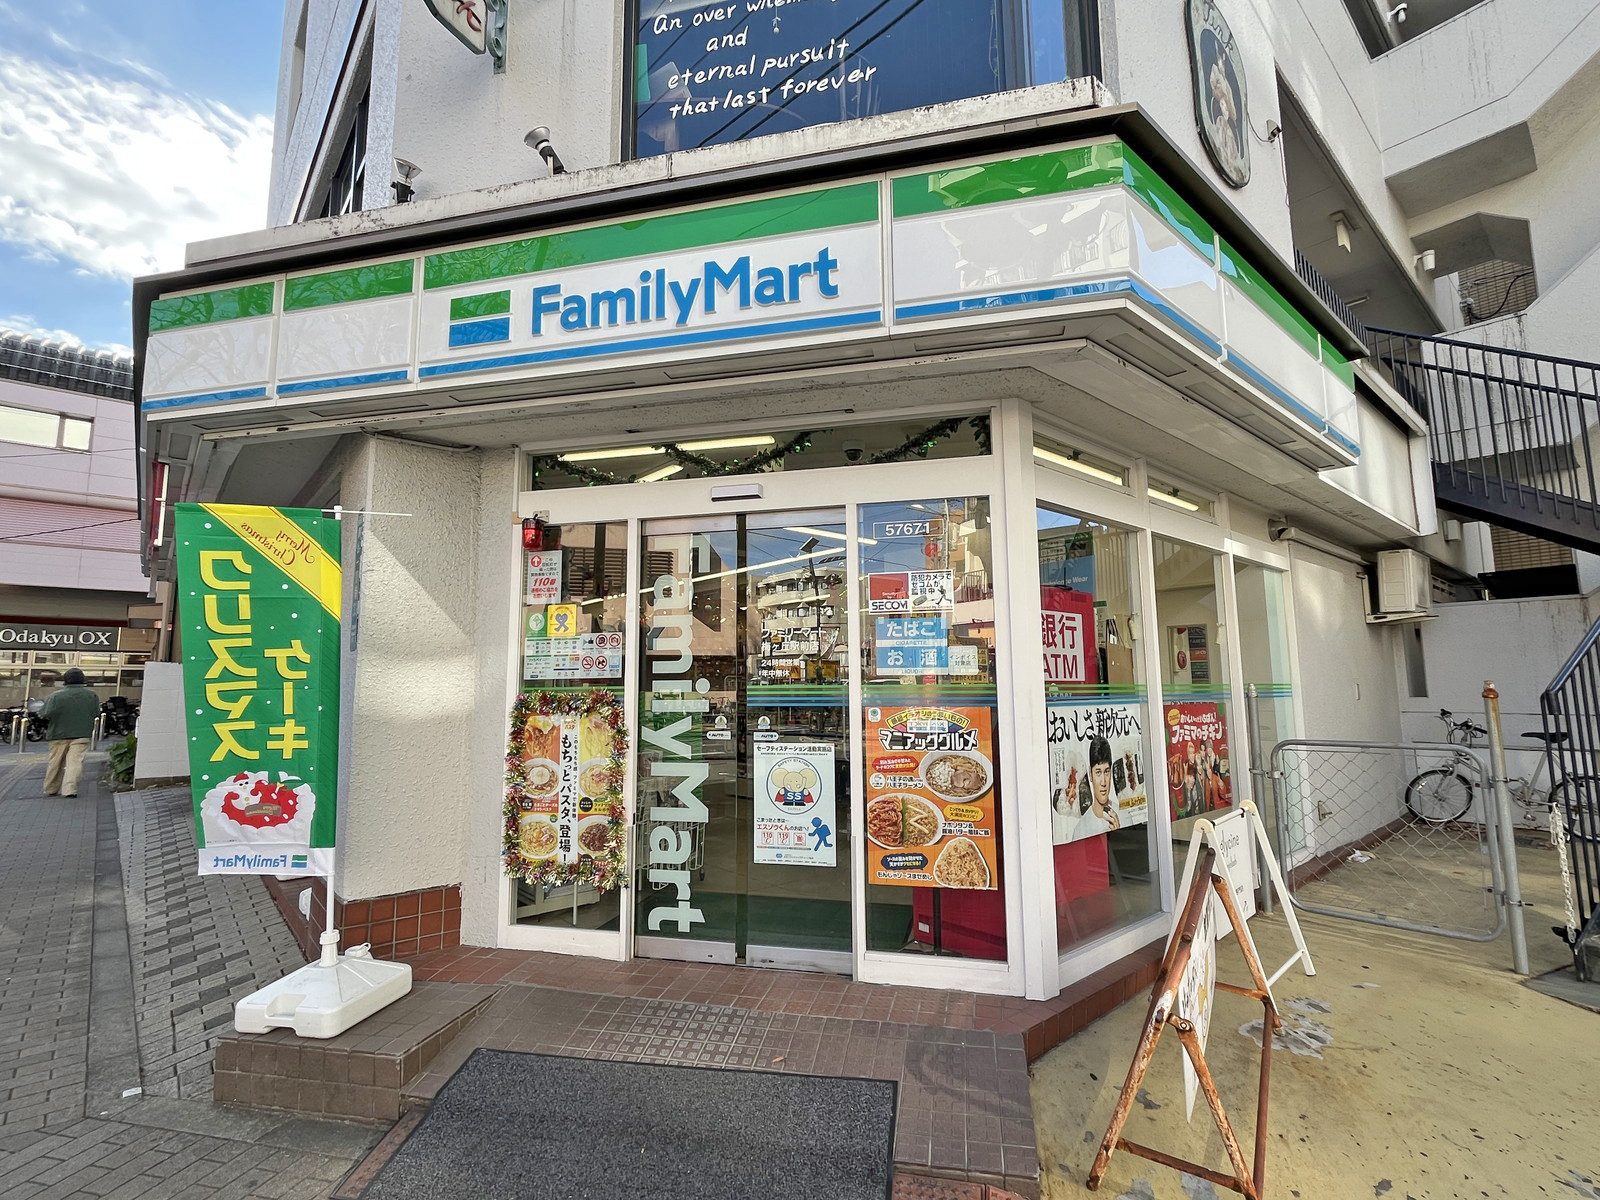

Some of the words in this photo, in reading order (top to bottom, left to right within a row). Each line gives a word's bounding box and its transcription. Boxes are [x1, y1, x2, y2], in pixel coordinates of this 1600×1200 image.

[653, 14, 682, 35] An
[692, 4, 737, 27] over
[706, 25, 749, 52] and
[668, 57, 755, 90] eternal
[761, 38, 850, 77] pursuit
[780, 63, 877, 100] forever
[531, 246, 839, 337] FamilyMart
[885, 522, 930, 536] 57671
[911, 573, 952, 581] 防犯カメラで
[911, 588, 936, 596] 監視中
[871, 600, 908, 610] SECOM
[0, 628, 74, 647] Odakyu
[78, 631, 113, 646] OX
[886, 620, 936, 637] たばこ
[1041, 613, 1078, 649] 銀行
[1042, 653, 1079, 680] ATM
[641, 533, 711, 933] FamilyMart
[879, 728, 978, 751] マニアックグルメ
[1171, 721, 1223, 744] ファミマのチキン
[786, 792, 802, 800] SS
